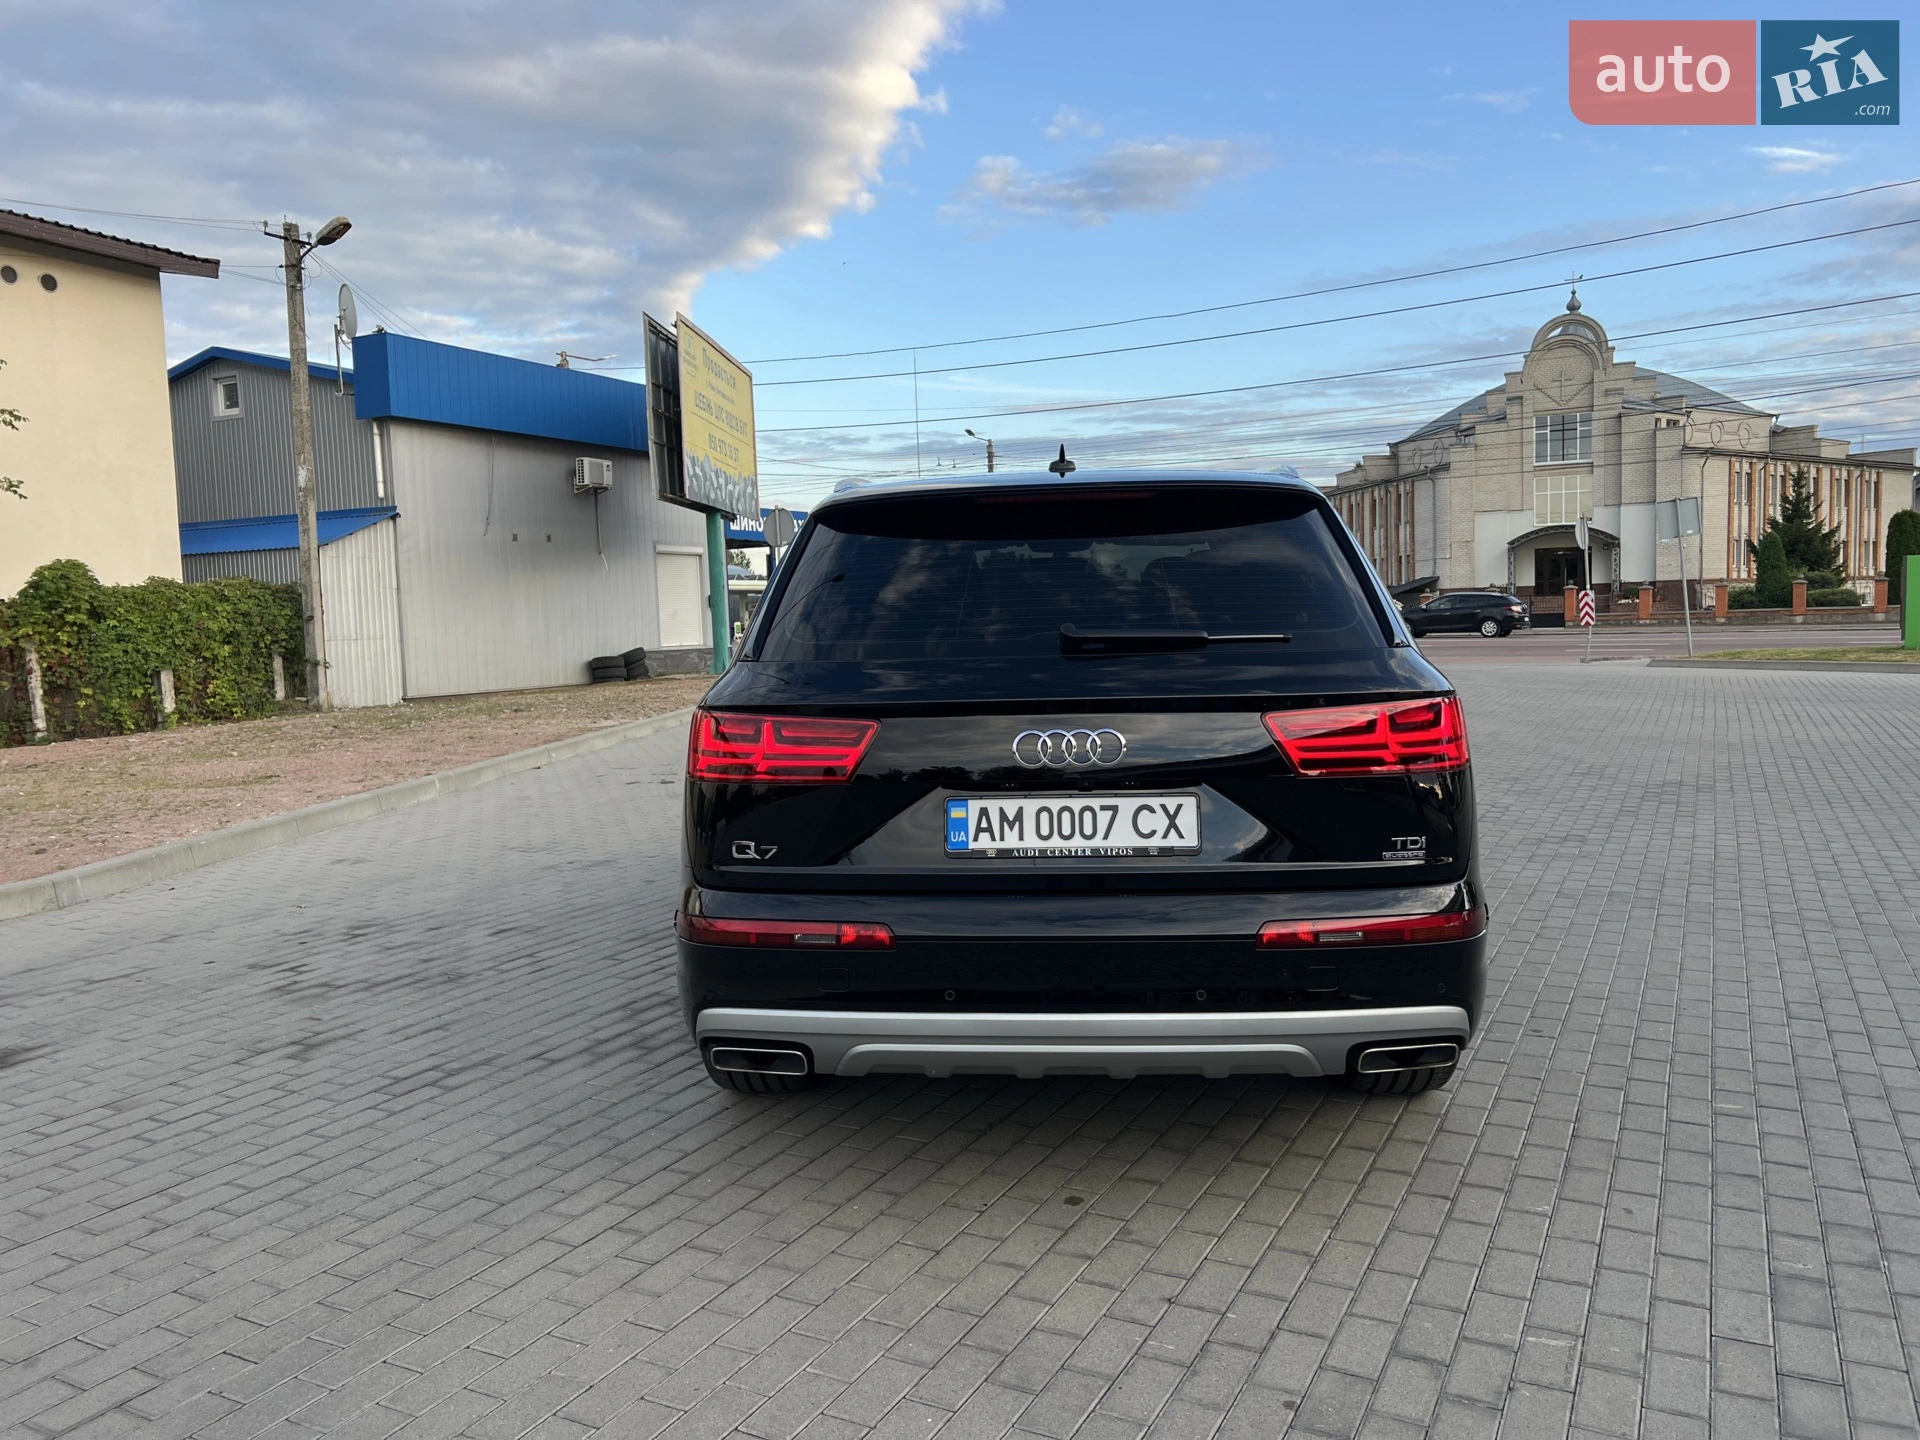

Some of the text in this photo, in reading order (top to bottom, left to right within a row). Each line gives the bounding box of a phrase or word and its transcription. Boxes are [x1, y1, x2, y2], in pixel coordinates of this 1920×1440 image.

[972, 803, 1186, 842] AM 0007 CX
[950, 831, 967, 842] UA
[732, 840, 778, 859] Q7
[1011, 847, 1134, 857] AUDI CENTER VIPOS
